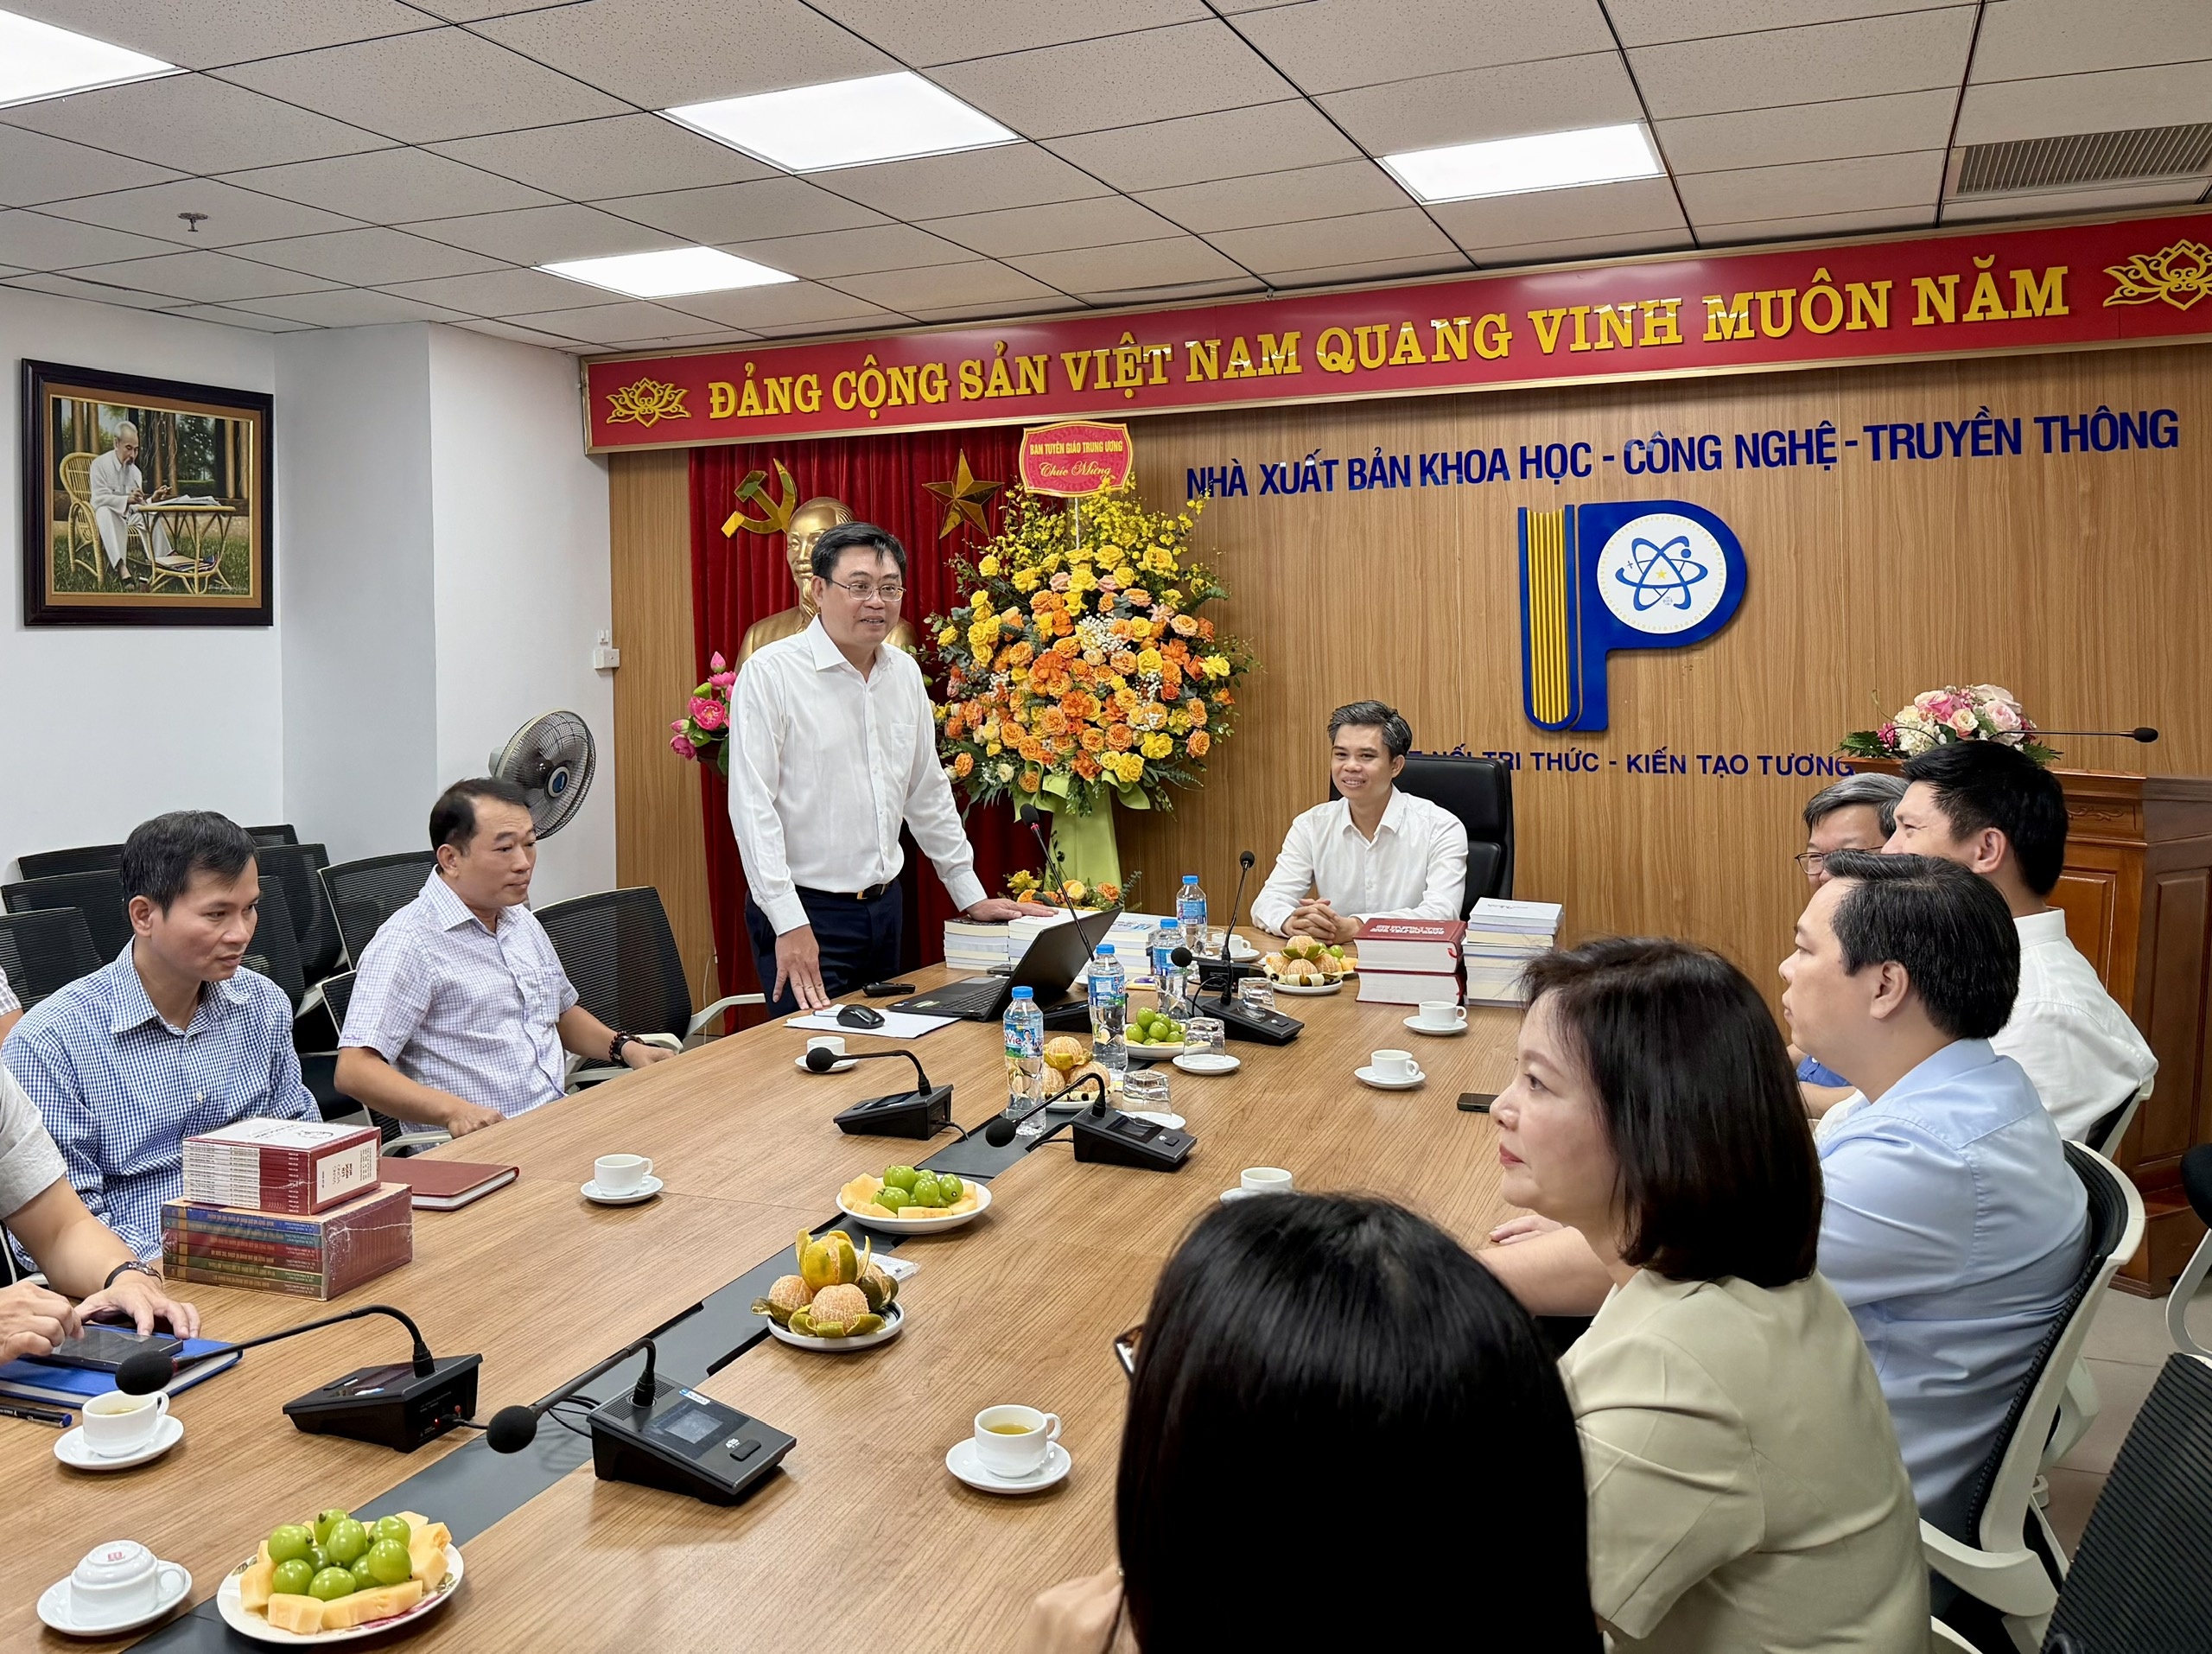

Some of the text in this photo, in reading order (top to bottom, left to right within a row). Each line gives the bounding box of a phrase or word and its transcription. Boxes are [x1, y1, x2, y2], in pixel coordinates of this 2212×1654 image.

[708, 254, 2069, 419] ĐẢNG CỘNG SẢN VIỆT NAM QUANG VINH MUÔN NĂM
[1029, 444, 1044, 455] BAN
[1065, 440, 1081, 454] GIÁO
[1082, 442, 1103, 453] TRUNG
[1104, 440, 1123, 452] ƯƠNG
[1186, 458, 1249, 499] NHÀ
[1259, 448, 1338, 495] XUẤT
[1348, 447, 1411, 491] BẢN
[1419, 448, 1510, 487] KHOA
[1519, 442, 1592, 485] HỌC
[1624, 430, 1722, 474] CÔNG
[1734, 420, 1838, 471] NGHỆ
[1863, 405, 2022, 461] TRUYỀN
[2033, 404, 2179, 454] THÔNG
[1039, 461, 1069, 477] Chúc
[1529, 747, 1599, 772] THỨC
[1626, 746, 1686, 774] KIẾN
[1696, 754, 1749, 779] TẠO
[1757, 753, 1854, 776] TƯƠNG
